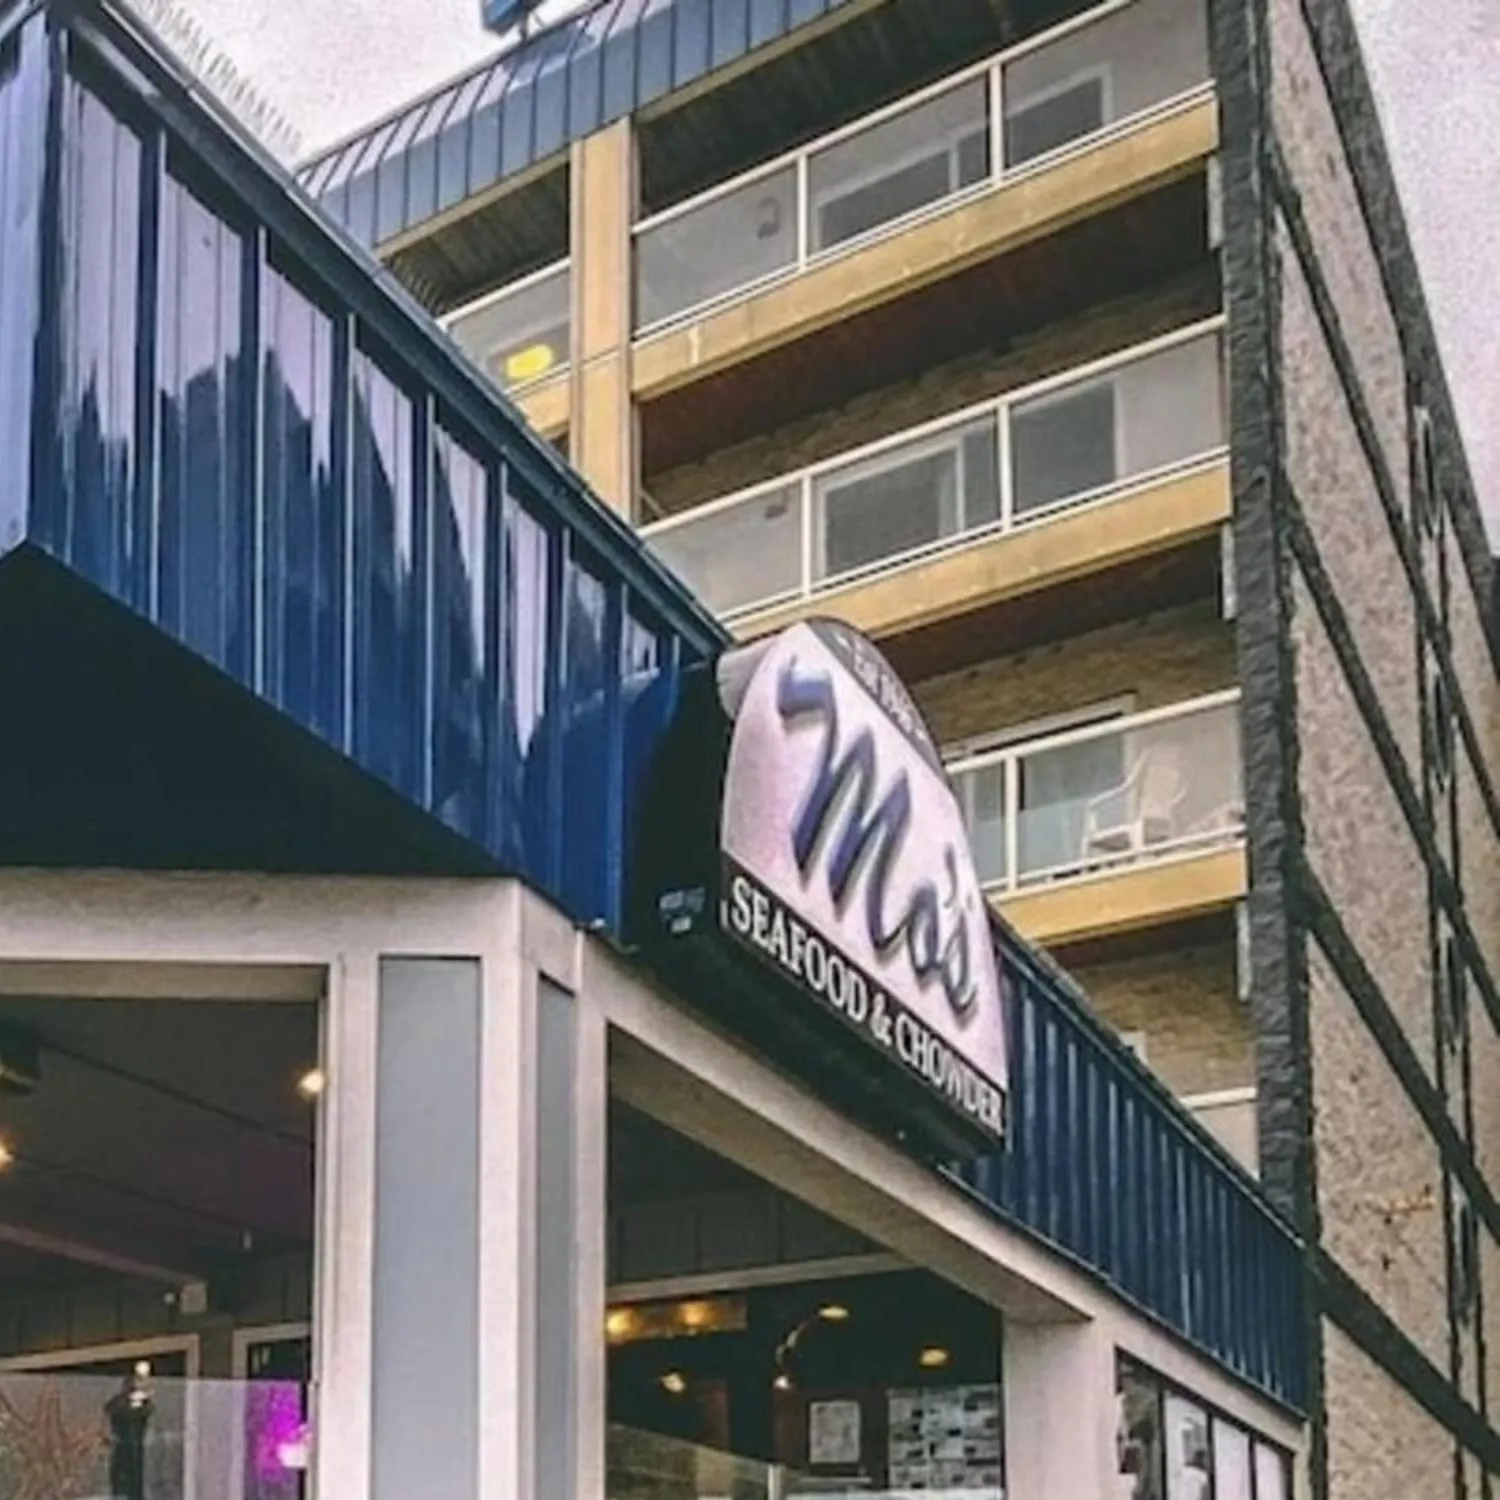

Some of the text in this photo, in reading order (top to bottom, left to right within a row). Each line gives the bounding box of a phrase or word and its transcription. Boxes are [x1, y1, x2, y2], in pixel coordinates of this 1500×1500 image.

[778, 656, 978, 1026] Mo's
[730, 877, 1005, 1137] SEAFOOD & CHOWDER
